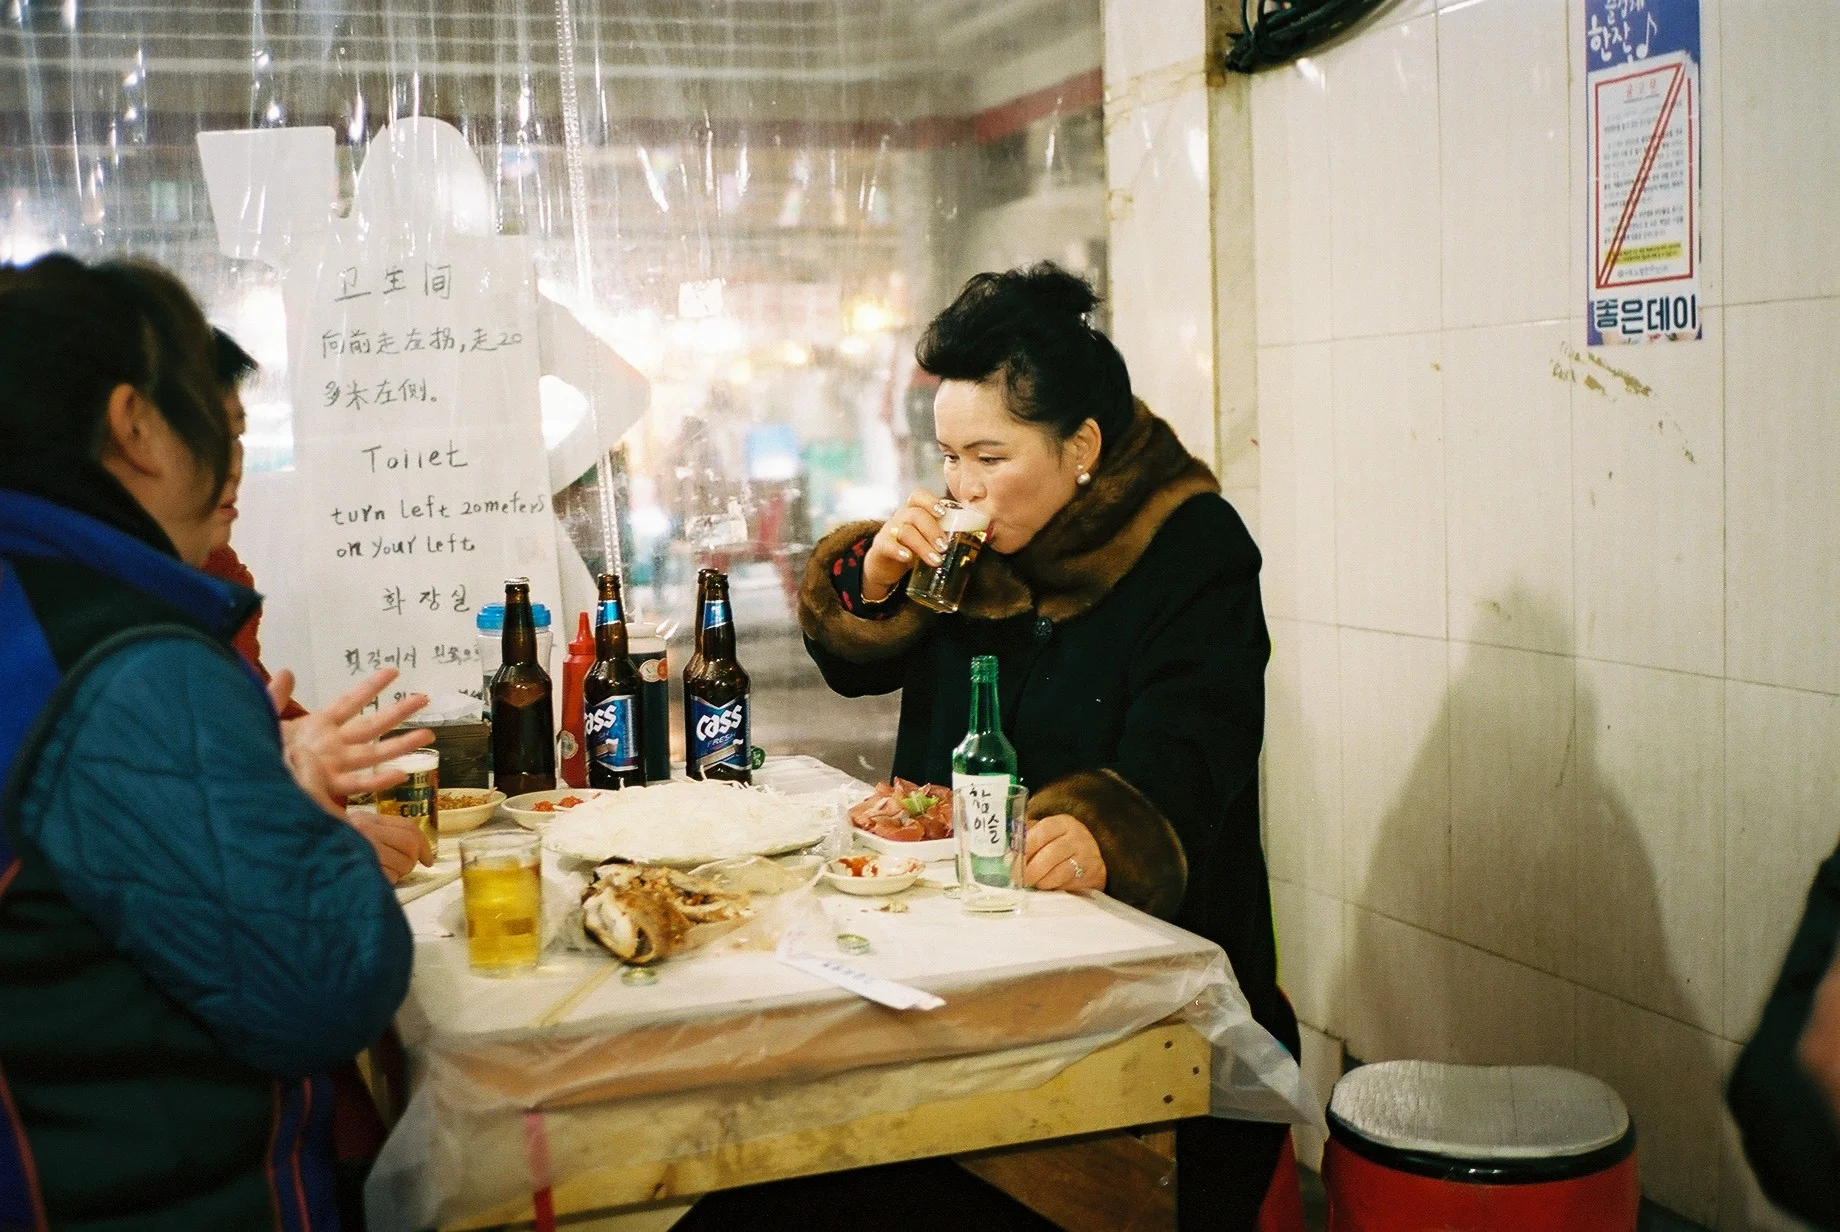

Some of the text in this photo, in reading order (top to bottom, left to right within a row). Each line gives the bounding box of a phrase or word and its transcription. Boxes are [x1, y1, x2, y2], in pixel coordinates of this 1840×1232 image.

[334, 262, 452, 302] 卫生间
[1596, 294, 1697, 335] 좋은데이
[362, 440, 468, 473] Toilet
[331, 504, 386, 525] turn
[401, 494, 451, 519] left
[337, 541, 363, 559] on
[584, 704, 618, 735] ass
